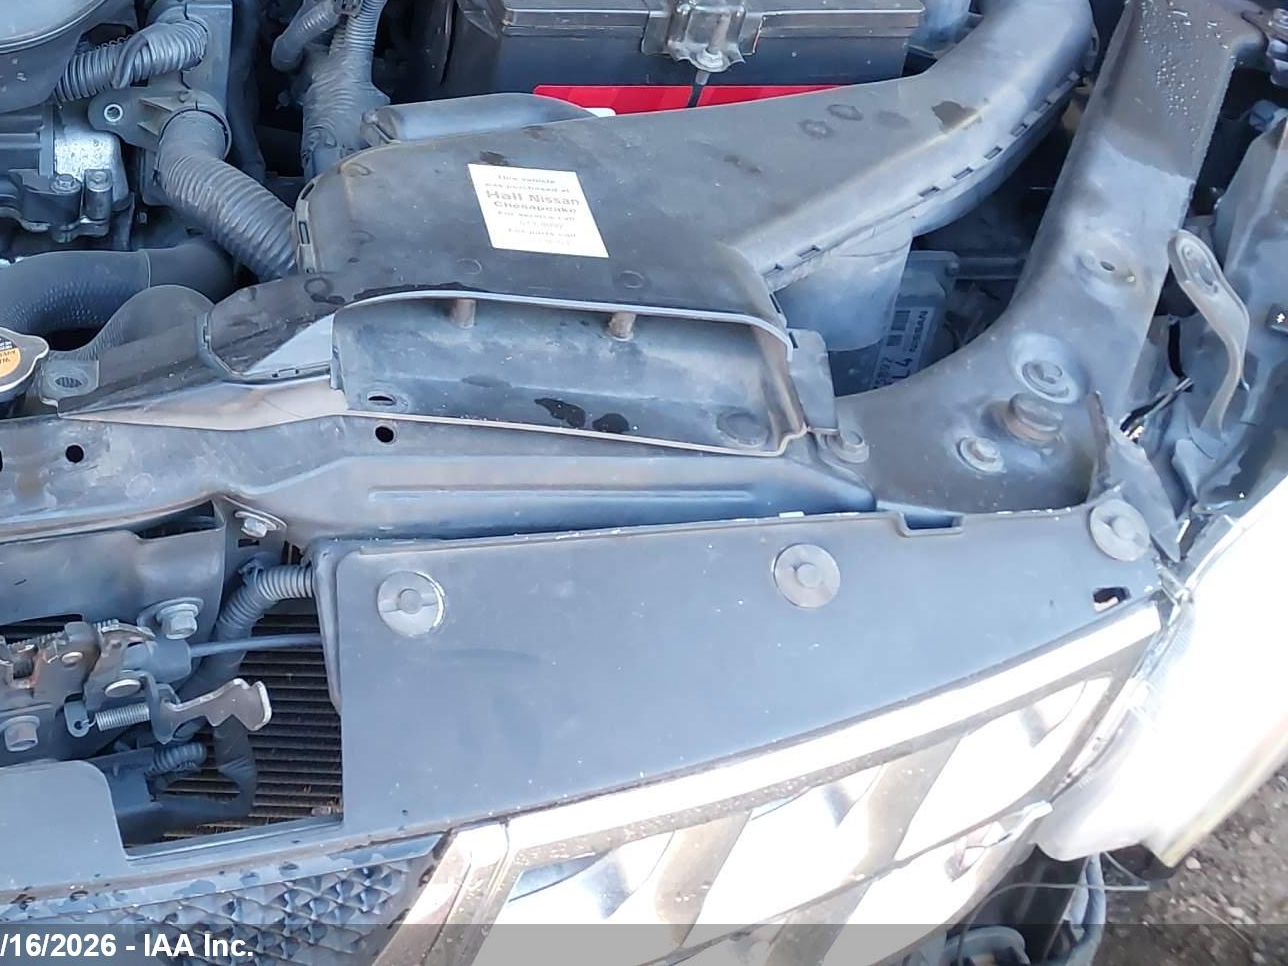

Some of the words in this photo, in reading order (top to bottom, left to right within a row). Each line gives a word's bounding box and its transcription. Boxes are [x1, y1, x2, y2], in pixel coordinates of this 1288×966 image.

[486, 190, 523, 202] Hall
[528, 194, 580, 207] Nissan
[493, 200, 577, 215] Chesapeake
[909, 310, 929, 352] NISSAN
